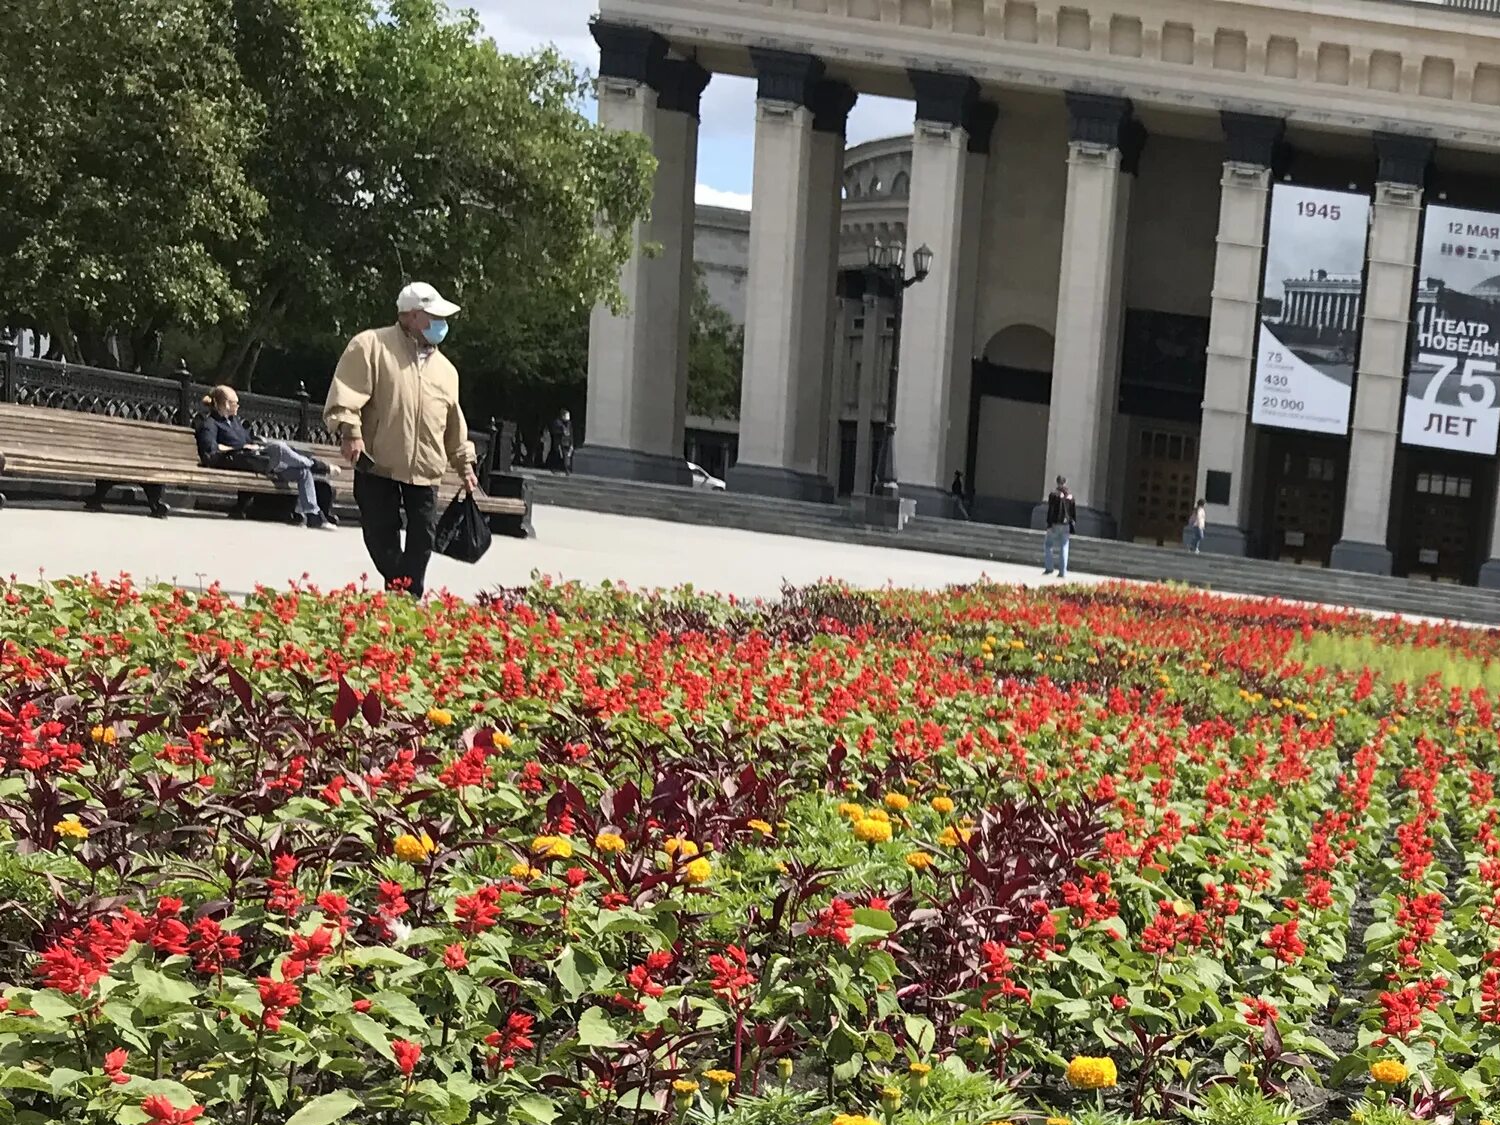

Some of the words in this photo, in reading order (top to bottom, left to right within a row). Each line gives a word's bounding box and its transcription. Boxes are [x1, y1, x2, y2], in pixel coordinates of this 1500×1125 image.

[1297, 201, 1341, 221] 1945
[1448, 222, 1464, 235] 12
[1466, 224, 1500, 239] МАЯ
[1434, 318, 1490, 337] ТЕАТР
[1419, 333, 1499, 357] ПОБЕДЫ
[1268, 351, 1283, 363] 75
[1264, 374, 1289, 387] 430
[1418, 353, 1497, 411] 75
[1262, 396, 1278, 408] 20
[1280, 398, 1305, 411] 000
[1424, 413, 1478, 437] ЛЕТ
